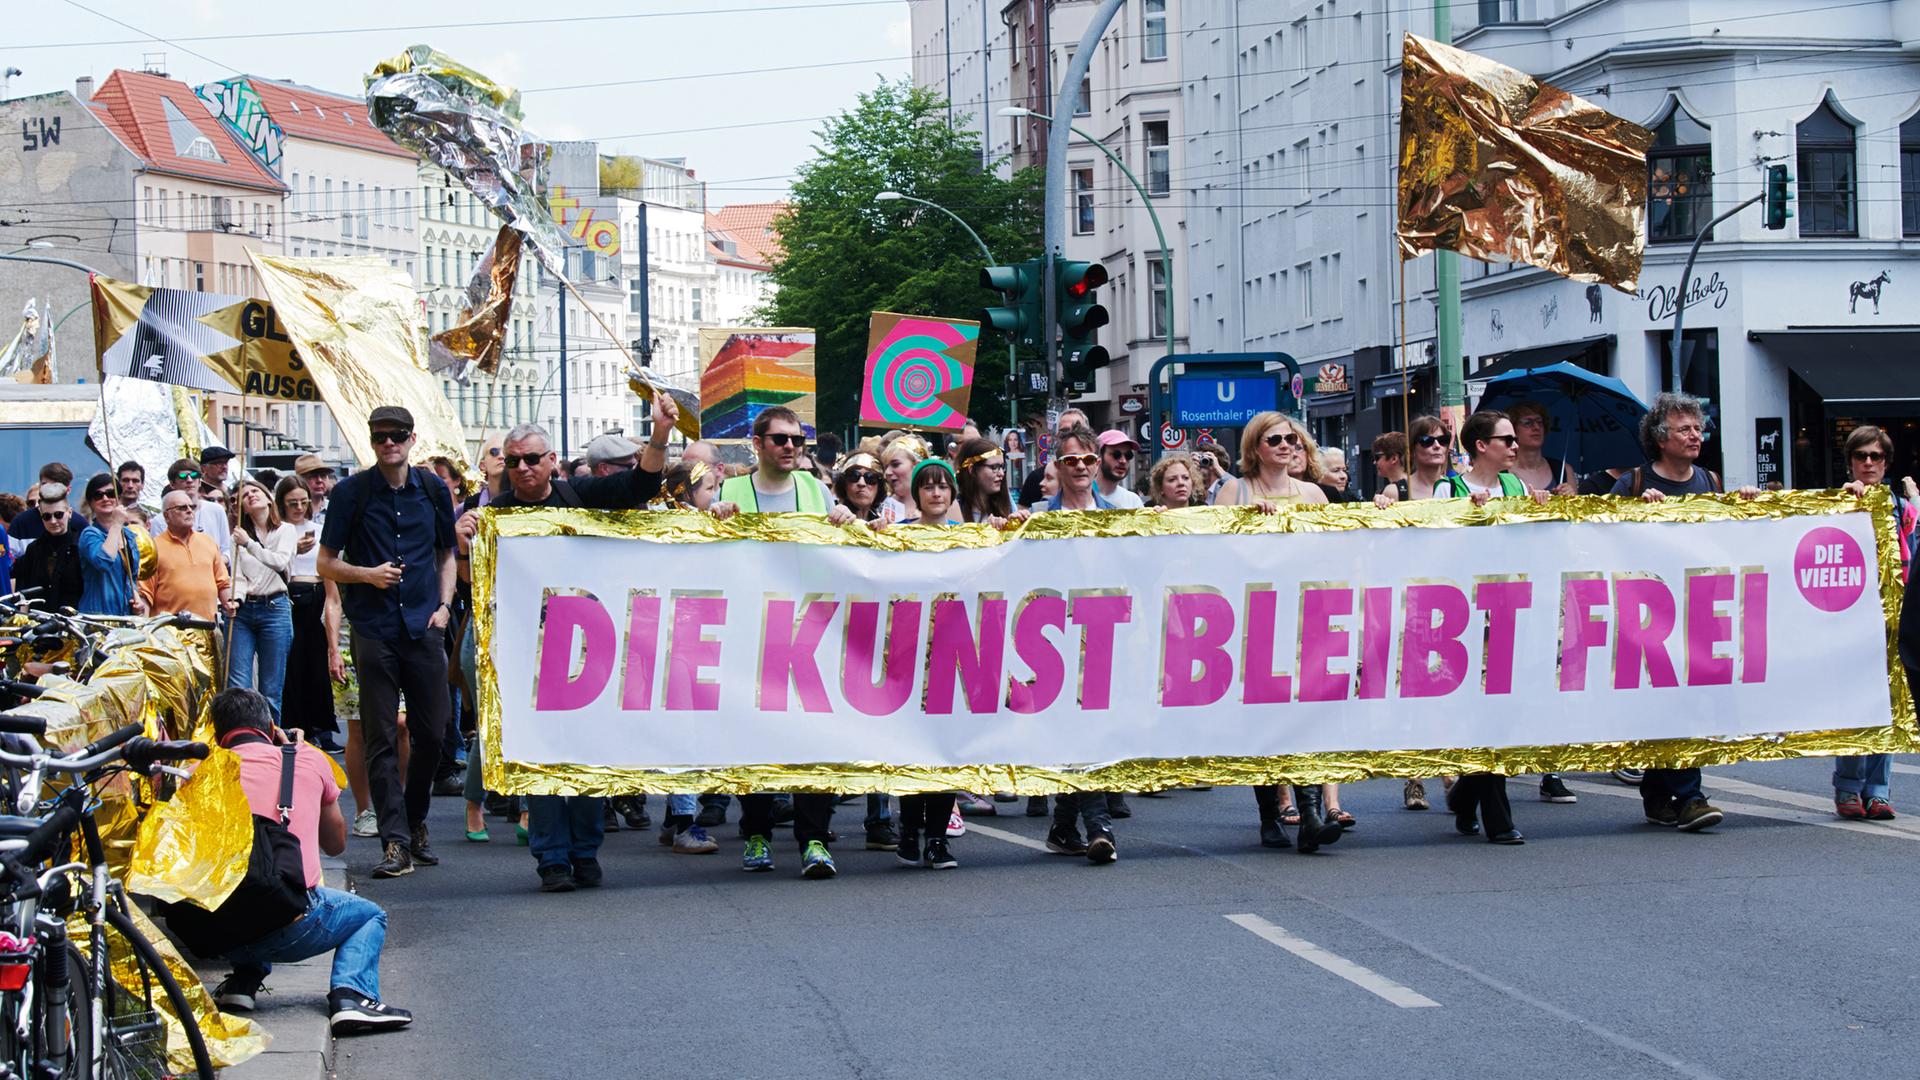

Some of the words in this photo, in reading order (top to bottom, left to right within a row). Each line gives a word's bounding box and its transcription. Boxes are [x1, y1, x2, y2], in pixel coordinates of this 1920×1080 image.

[23, 117, 61, 152] SW
[1647, 272, 1728, 321] Obrholz
[242, 302, 293, 342] GL
[288, 349, 305, 371] S
[245, 370, 323, 402] AUSG
[1217, 381, 1235, 402] U
[1181, 409, 1243, 421] Rosenthaler
[1246, 409, 1265, 420] Pl
[1165, 429, 1180, 441] 30
[1758, 454, 1770, 463] DAS
[1758, 463, 1777, 472] LEBEN
[1759, 473, 1768, 482] IST
[1815, 544, 1844, 565] DIE
[1800, 566, 1861, 588] VIELEN
[531, 587, 728, 711] DIE
[755, 587, 1133, 716] KUNST
[1157, 573, 1533, 707] BLEIBT
[1556, 565, 1768, 692] FREI
